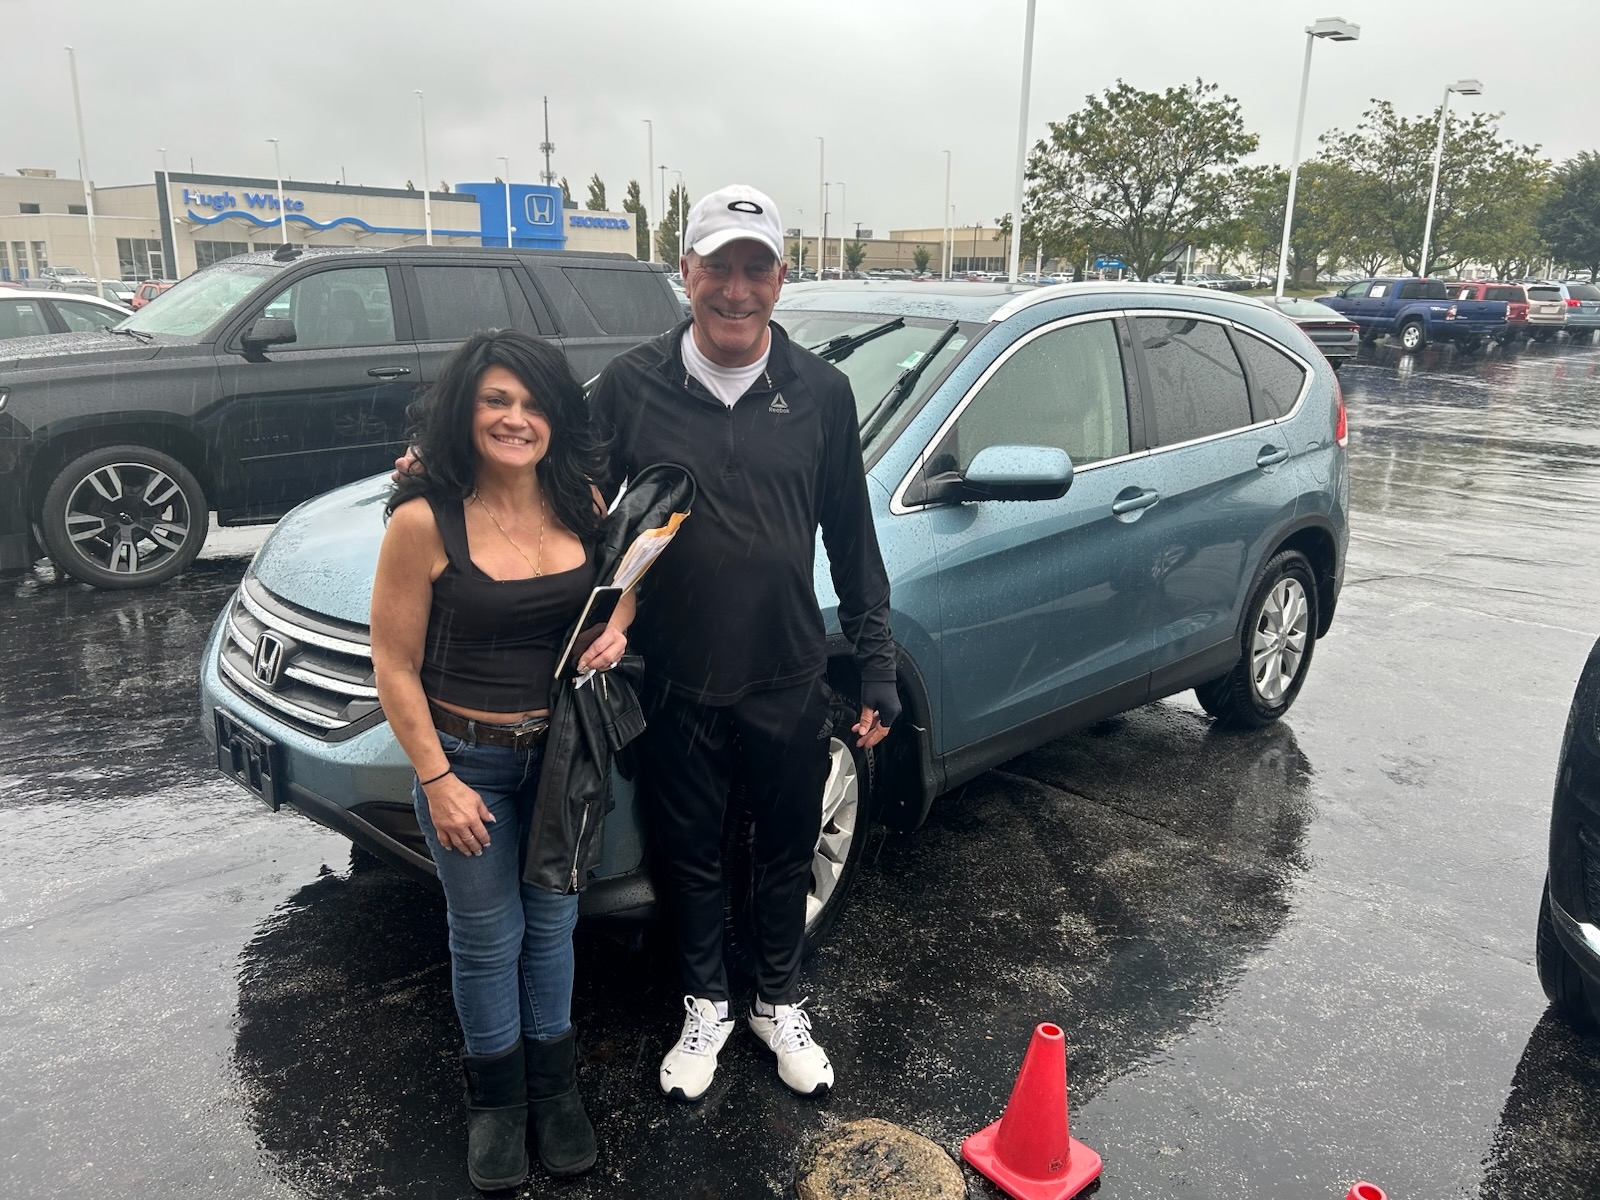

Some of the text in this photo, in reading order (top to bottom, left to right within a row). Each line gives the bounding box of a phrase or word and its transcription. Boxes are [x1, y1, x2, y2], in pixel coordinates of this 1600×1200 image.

[183, 188, 304, 211] Hugh Whte
[569, 215, 630, 230] HONDA
